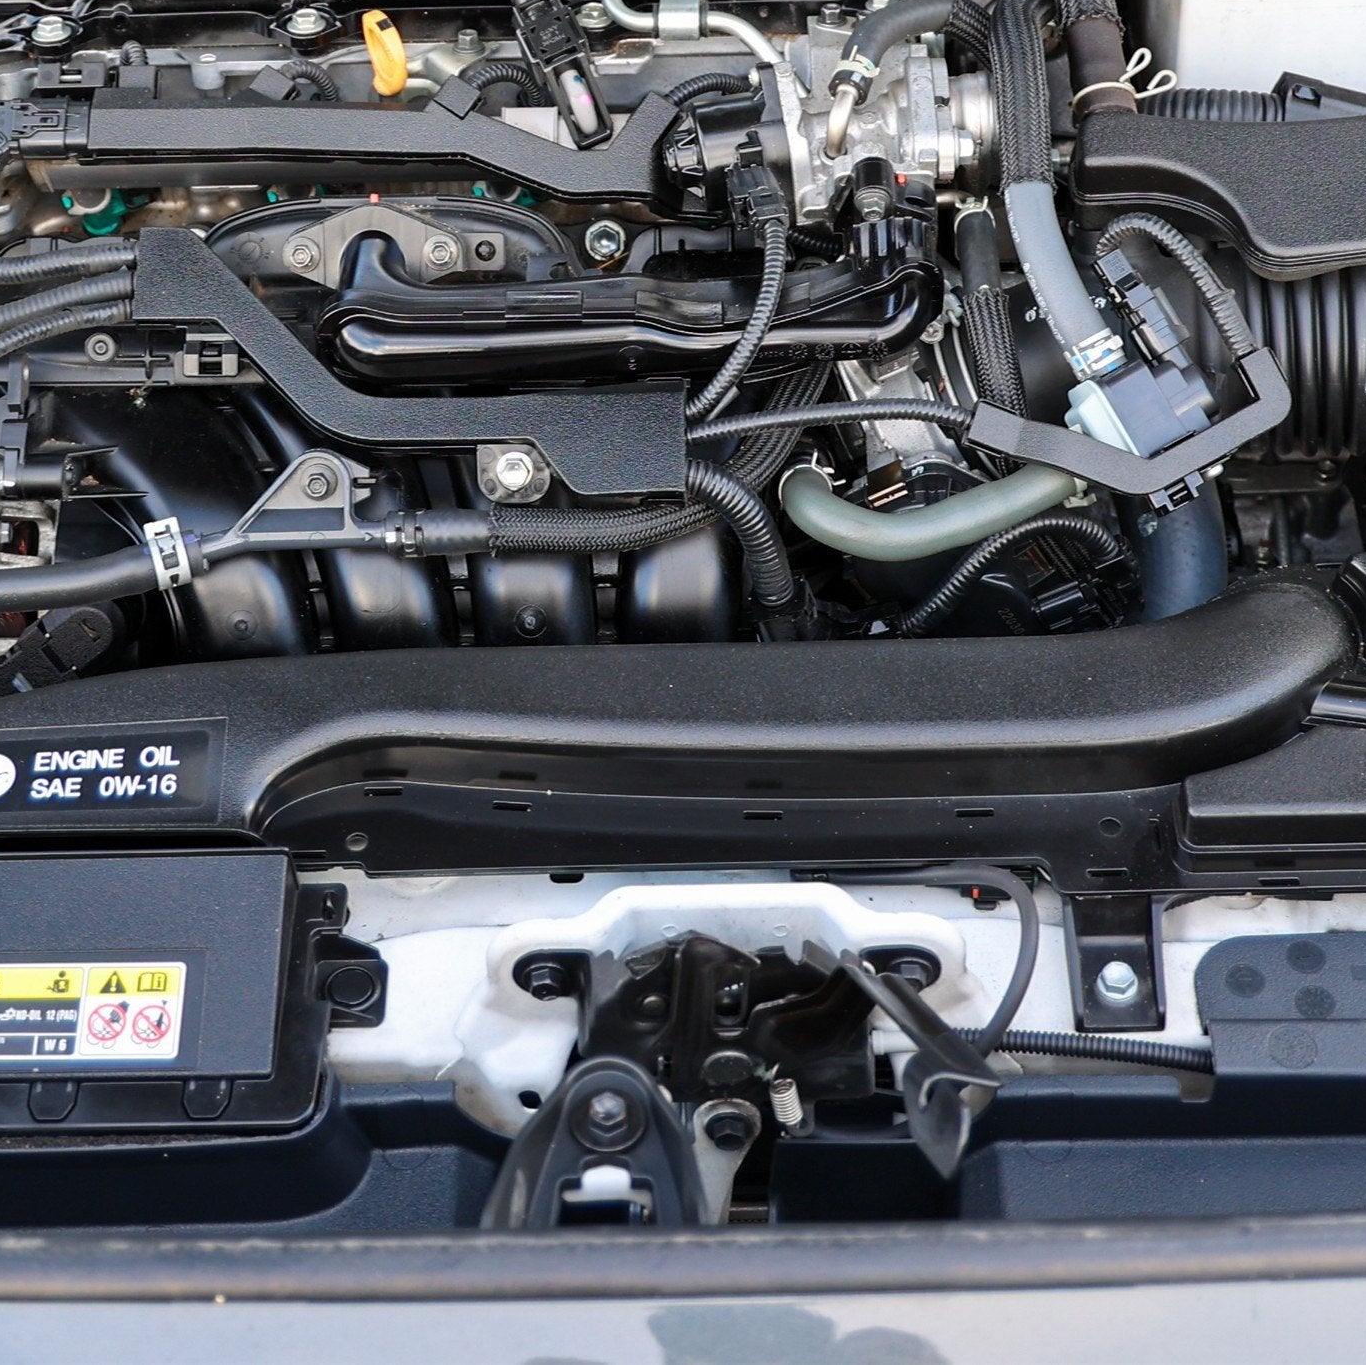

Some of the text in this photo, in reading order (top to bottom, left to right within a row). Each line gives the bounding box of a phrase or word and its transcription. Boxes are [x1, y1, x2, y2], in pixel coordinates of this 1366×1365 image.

[33, 745, 181, 772] ENGINE OIL
[30, 773, 178, 799] SAE 0W-16
